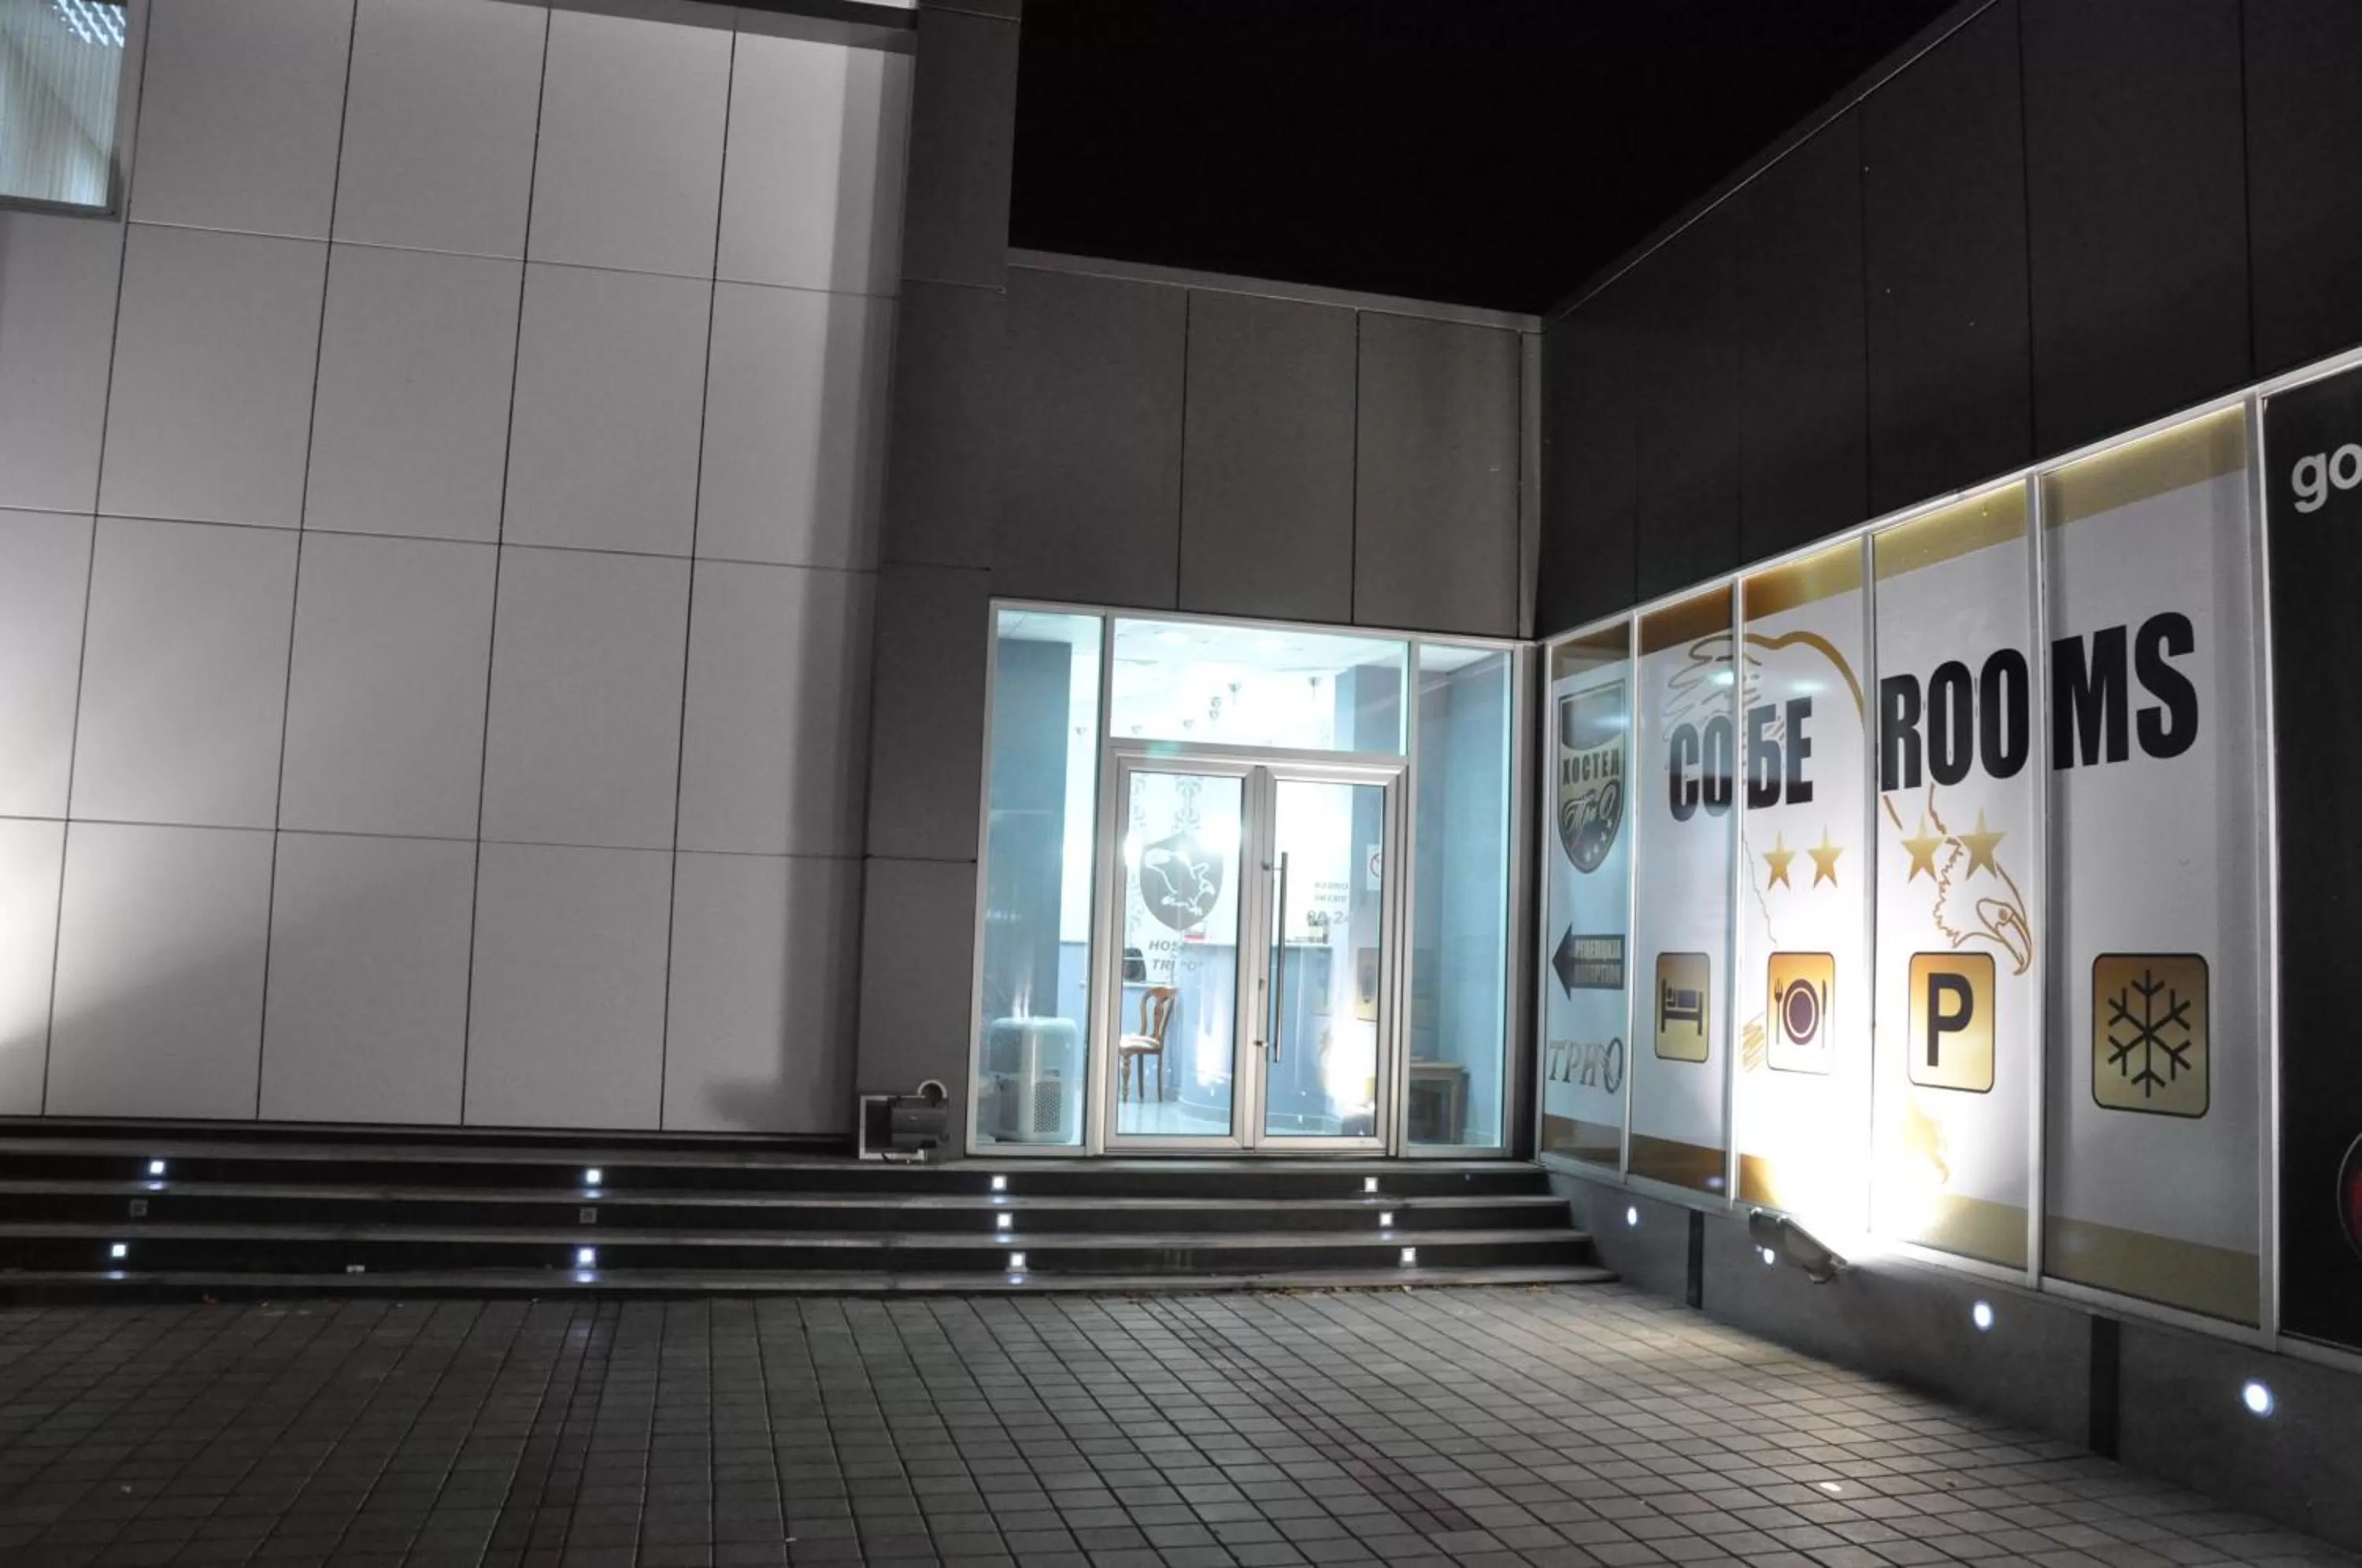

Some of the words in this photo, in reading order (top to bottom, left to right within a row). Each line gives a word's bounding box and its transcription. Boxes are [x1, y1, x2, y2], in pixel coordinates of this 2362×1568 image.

[2291, 442, 2362, 514] go
[1879, 611, 2199, 793] ROOMS
[1562, 748, 1620, 786] ХОСТЕЛ
[1669, 696, 1813, 823] СОБЕ
